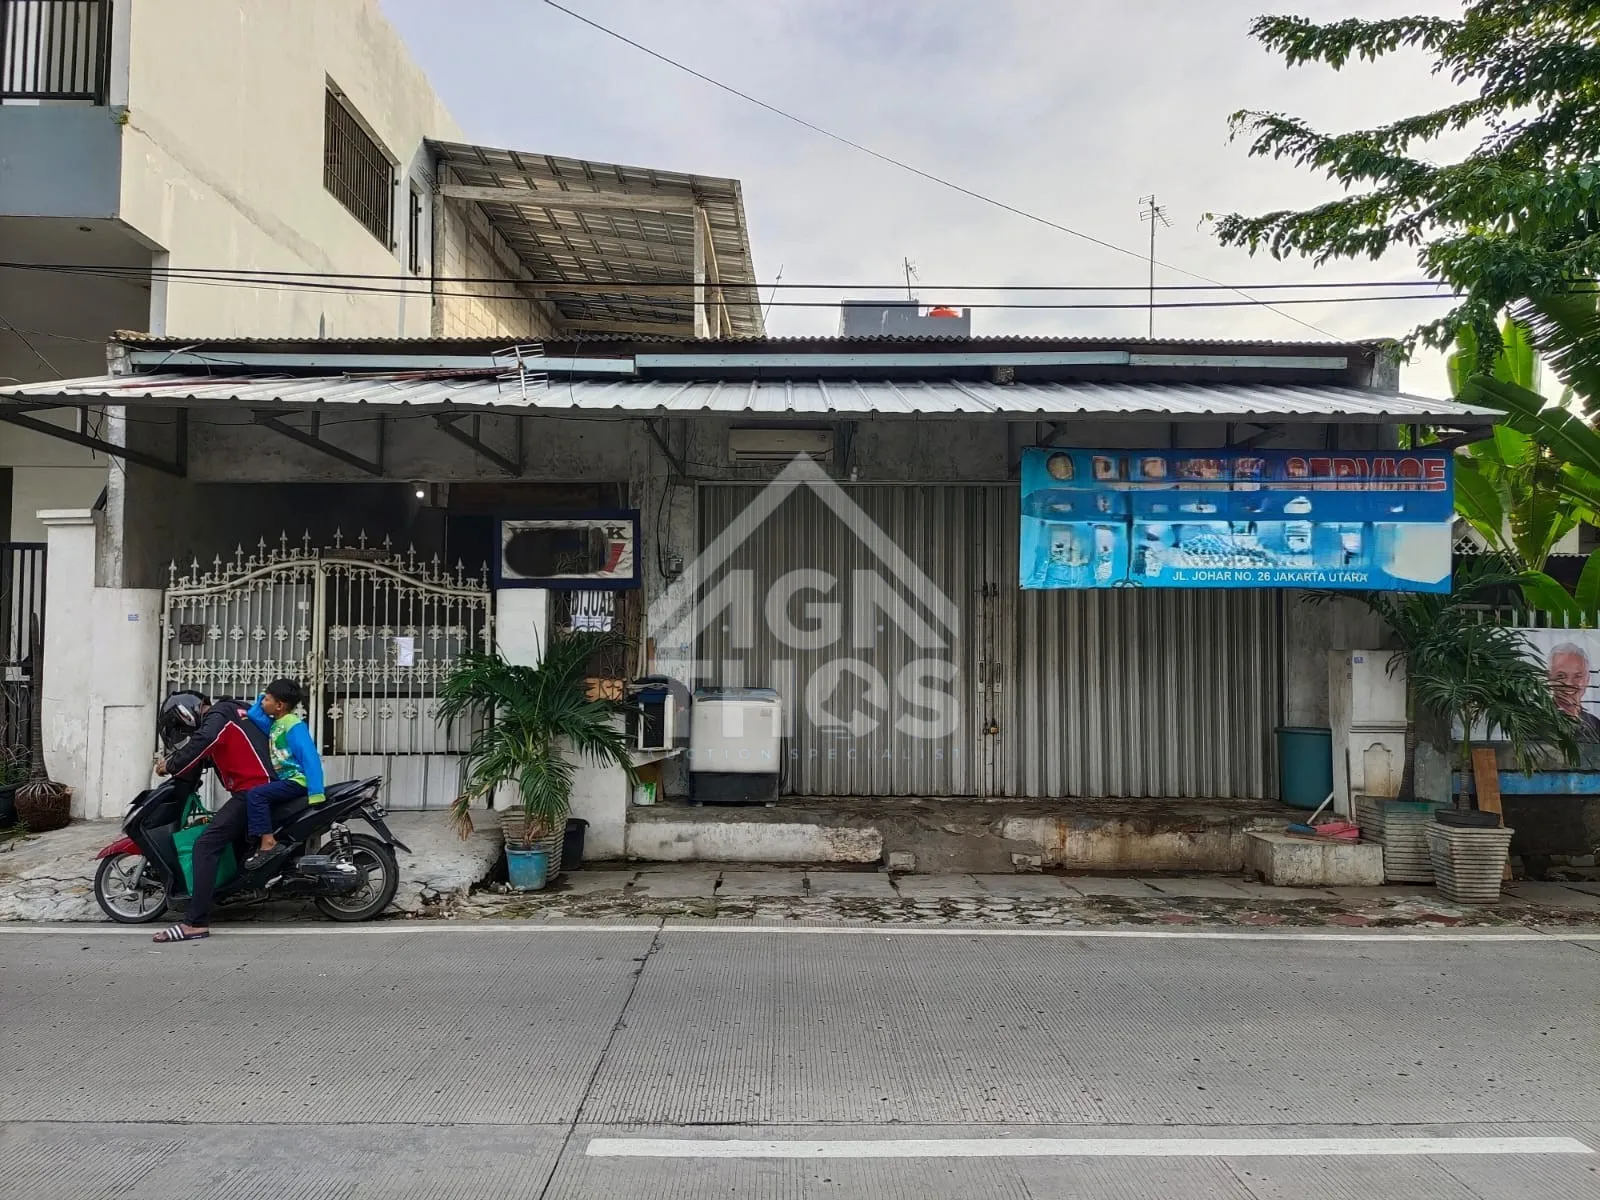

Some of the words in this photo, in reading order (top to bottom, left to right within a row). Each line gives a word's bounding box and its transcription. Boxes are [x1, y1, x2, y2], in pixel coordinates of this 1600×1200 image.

[1173, 571, 1189, 581] JL.
[1192, 571, 1232, 581] JOHAR
[1234, 571, 1255, 581] NO.
[1257, 571, 1271, 581] 26
[1273, 571, 1326, 582] JAKARTA
[1328, 572, 1369, 583] UTARA
